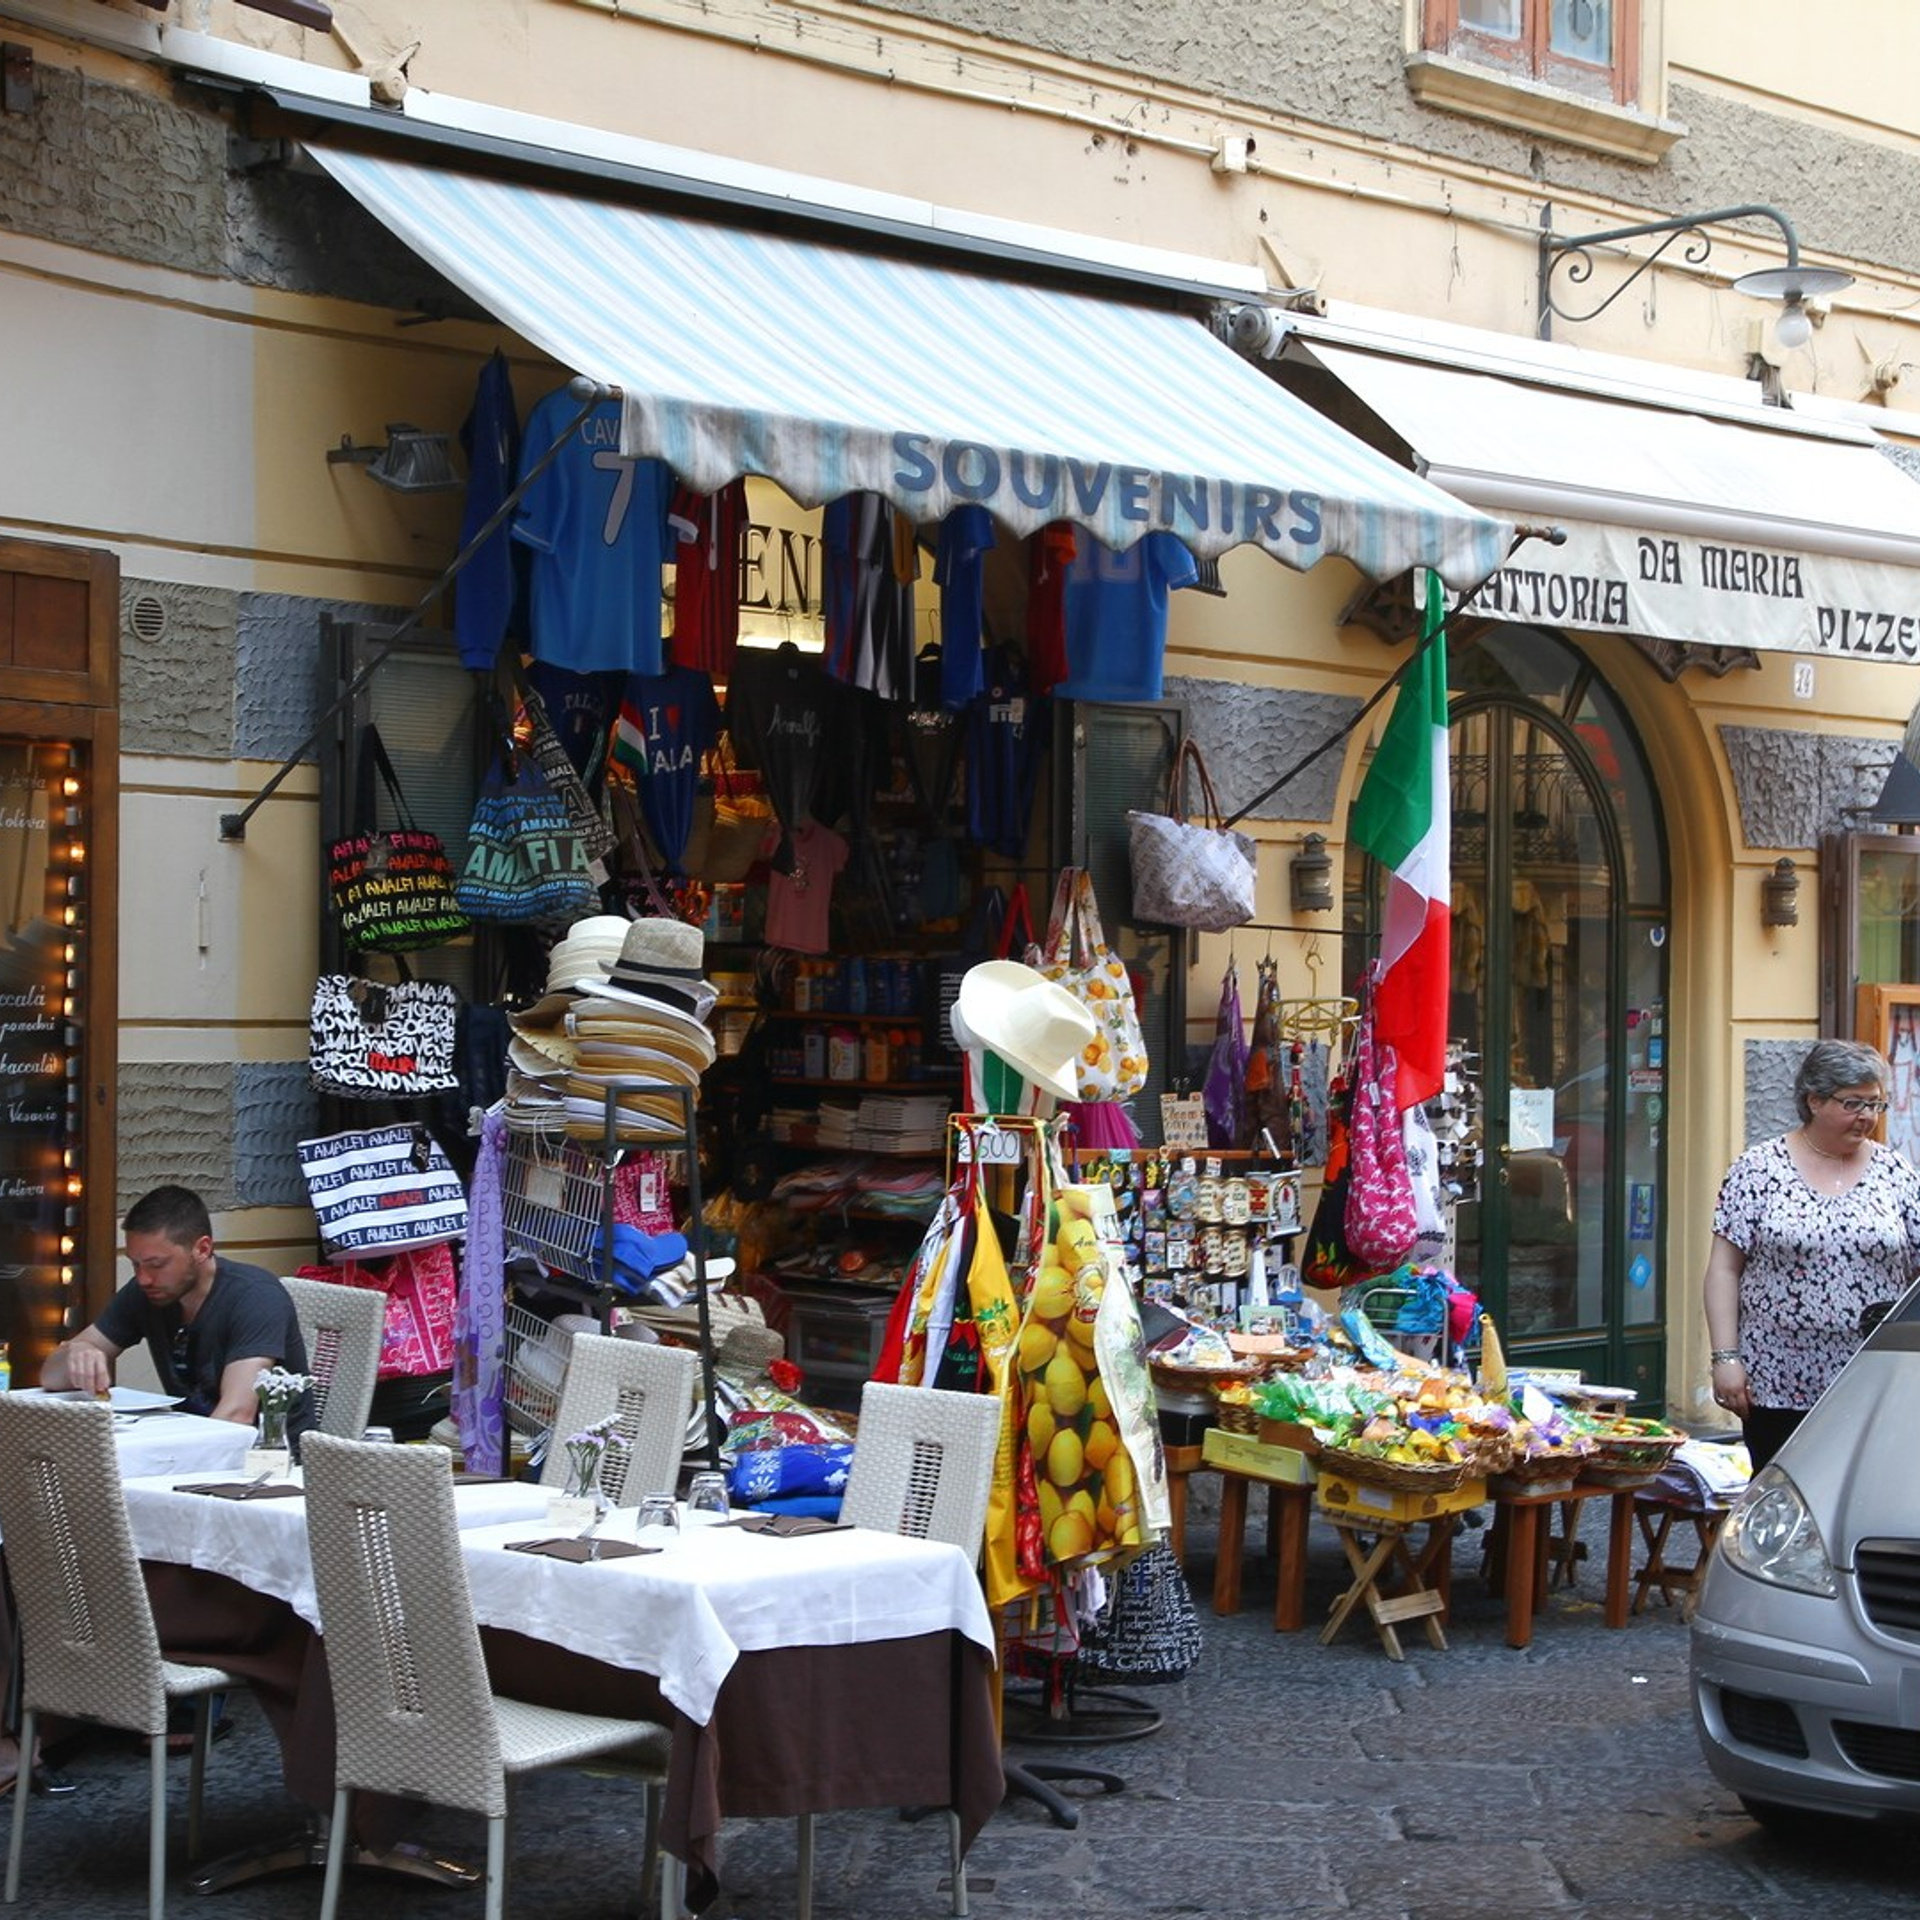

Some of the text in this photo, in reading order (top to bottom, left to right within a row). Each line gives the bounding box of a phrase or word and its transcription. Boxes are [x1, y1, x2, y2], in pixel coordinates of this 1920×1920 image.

[592, 450, 637, 546] 7
[892, 430, 1323, 546] SOUVENIRS
[1638, 536, 1804, 599] DA MARIA
[1443, 566, 1630, 627] ATTORIA
[1816, 605, 1920, 658] PIZZE
[313, 1135, 365, 1157] AMALFI
[349, 1161, 398, 1181] AMALFI
[330, 1196, 378, 1220] AMALFI
[366, 1223, 409, 1243] AMALFI
[413, 1216, 458, 1236] AMALFI
